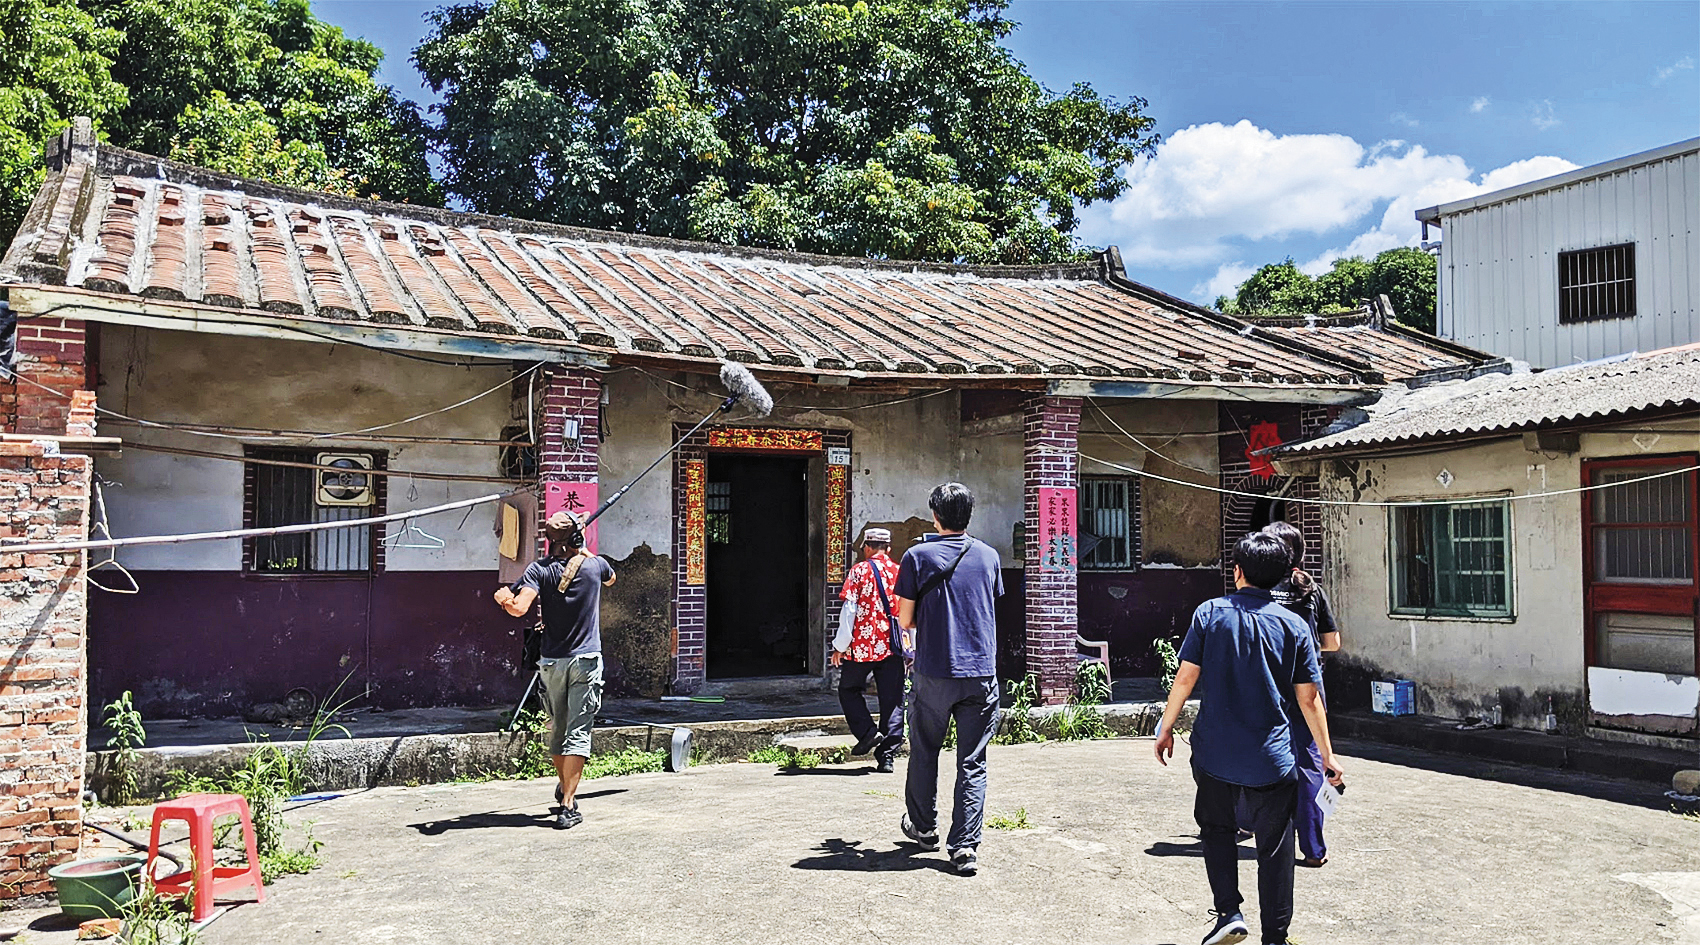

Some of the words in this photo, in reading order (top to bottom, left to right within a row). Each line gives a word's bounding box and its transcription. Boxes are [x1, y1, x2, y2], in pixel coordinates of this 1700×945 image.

[834, 455, 844, 464] 15
[561, 491, 585, 510] 恭
[1046, 496, 1058, 566] 家家必樂太平春
